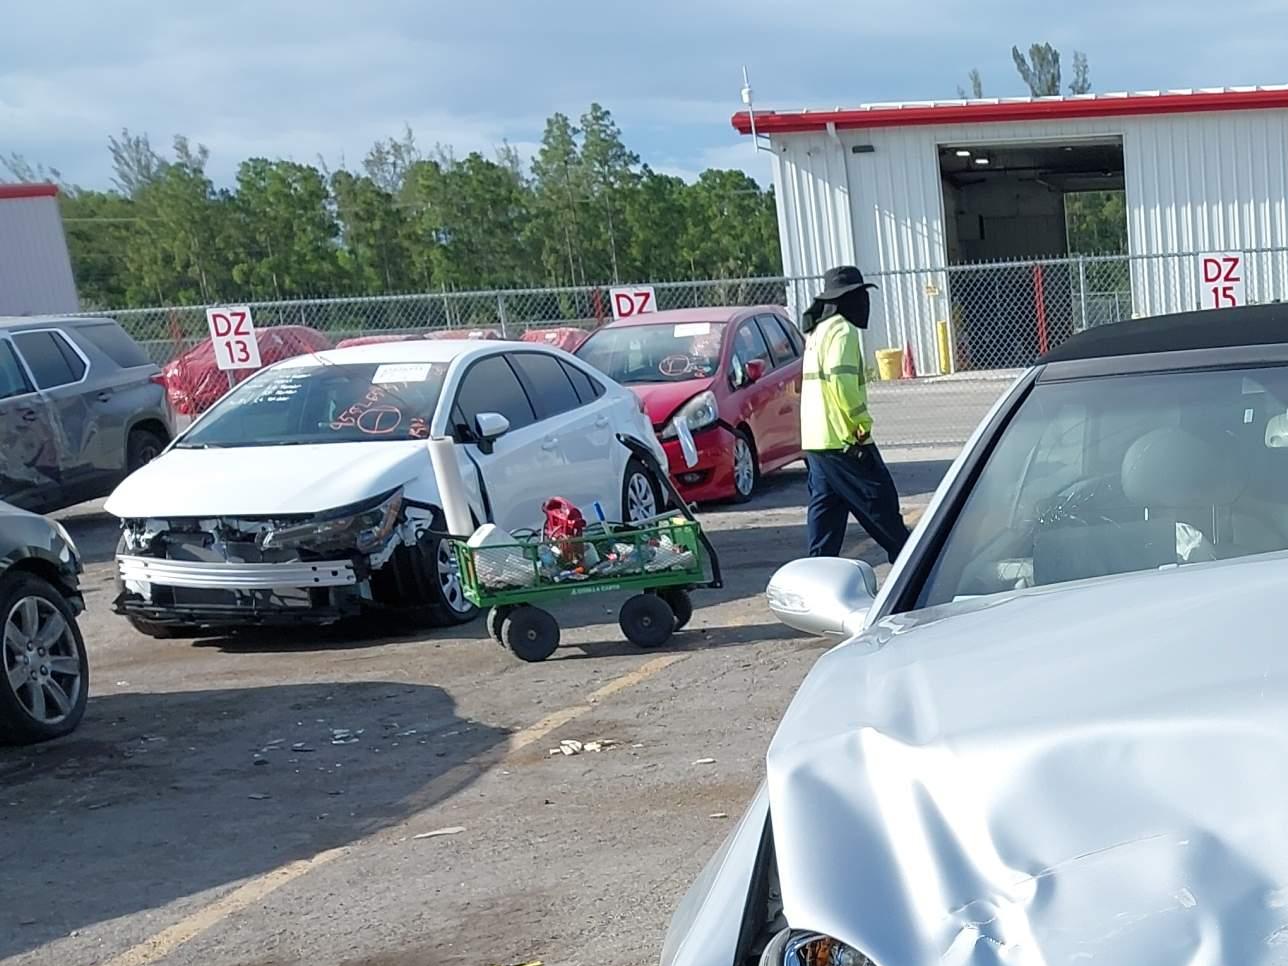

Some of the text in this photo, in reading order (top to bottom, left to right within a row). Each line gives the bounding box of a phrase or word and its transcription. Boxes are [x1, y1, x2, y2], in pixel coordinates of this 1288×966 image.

[1203, 257, 1241, 282] DZ
[615, 291, 652, 317] DZ
[1211, 286, 1236, 309] 15
[212, 312, 250, 337] DZ
[225, 340, 250, 363] 13
